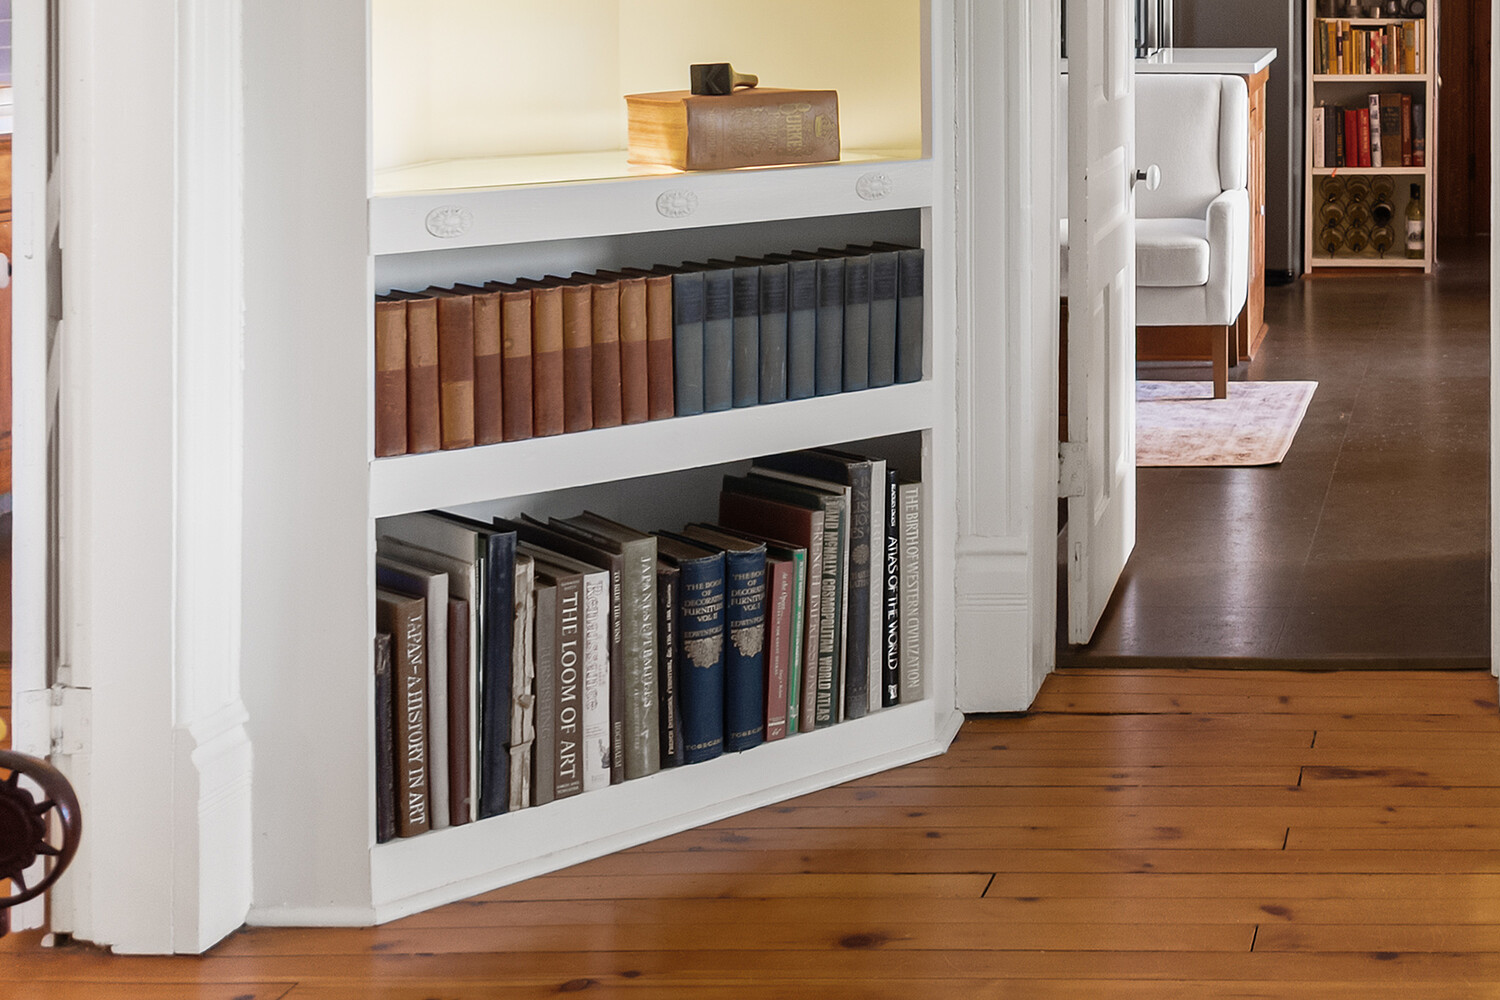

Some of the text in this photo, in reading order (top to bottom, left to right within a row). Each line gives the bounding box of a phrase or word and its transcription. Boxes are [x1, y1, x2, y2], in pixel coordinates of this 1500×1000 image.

[614, 570, 620, 582] TO
[687, 583, 704, 591] THE
[747, 579, 757, 587] OF
[905, 487, 920, 688] THE BIRTH OF WESTERN CIVILIZATION
[701, 589, 712, 597] OF
[887, 536, 898, 670] ATLAS OF THE WORLD
[562, 591, 578, 636] THE
[820, 578, 836, 653] COSMOPOLITAN
[561, 641, 578, 703] LOOM
[818, 656, 833, 689] WORLD
[560, 707, 577, 734] OF
[816, 692, 832, 721] ATLAS
[407, 691, 425, 764] HISTORY
[559, 740, 576, 779] ART
[408, 768, 425, 790] IN
[408, 793, 426, 825] ART
